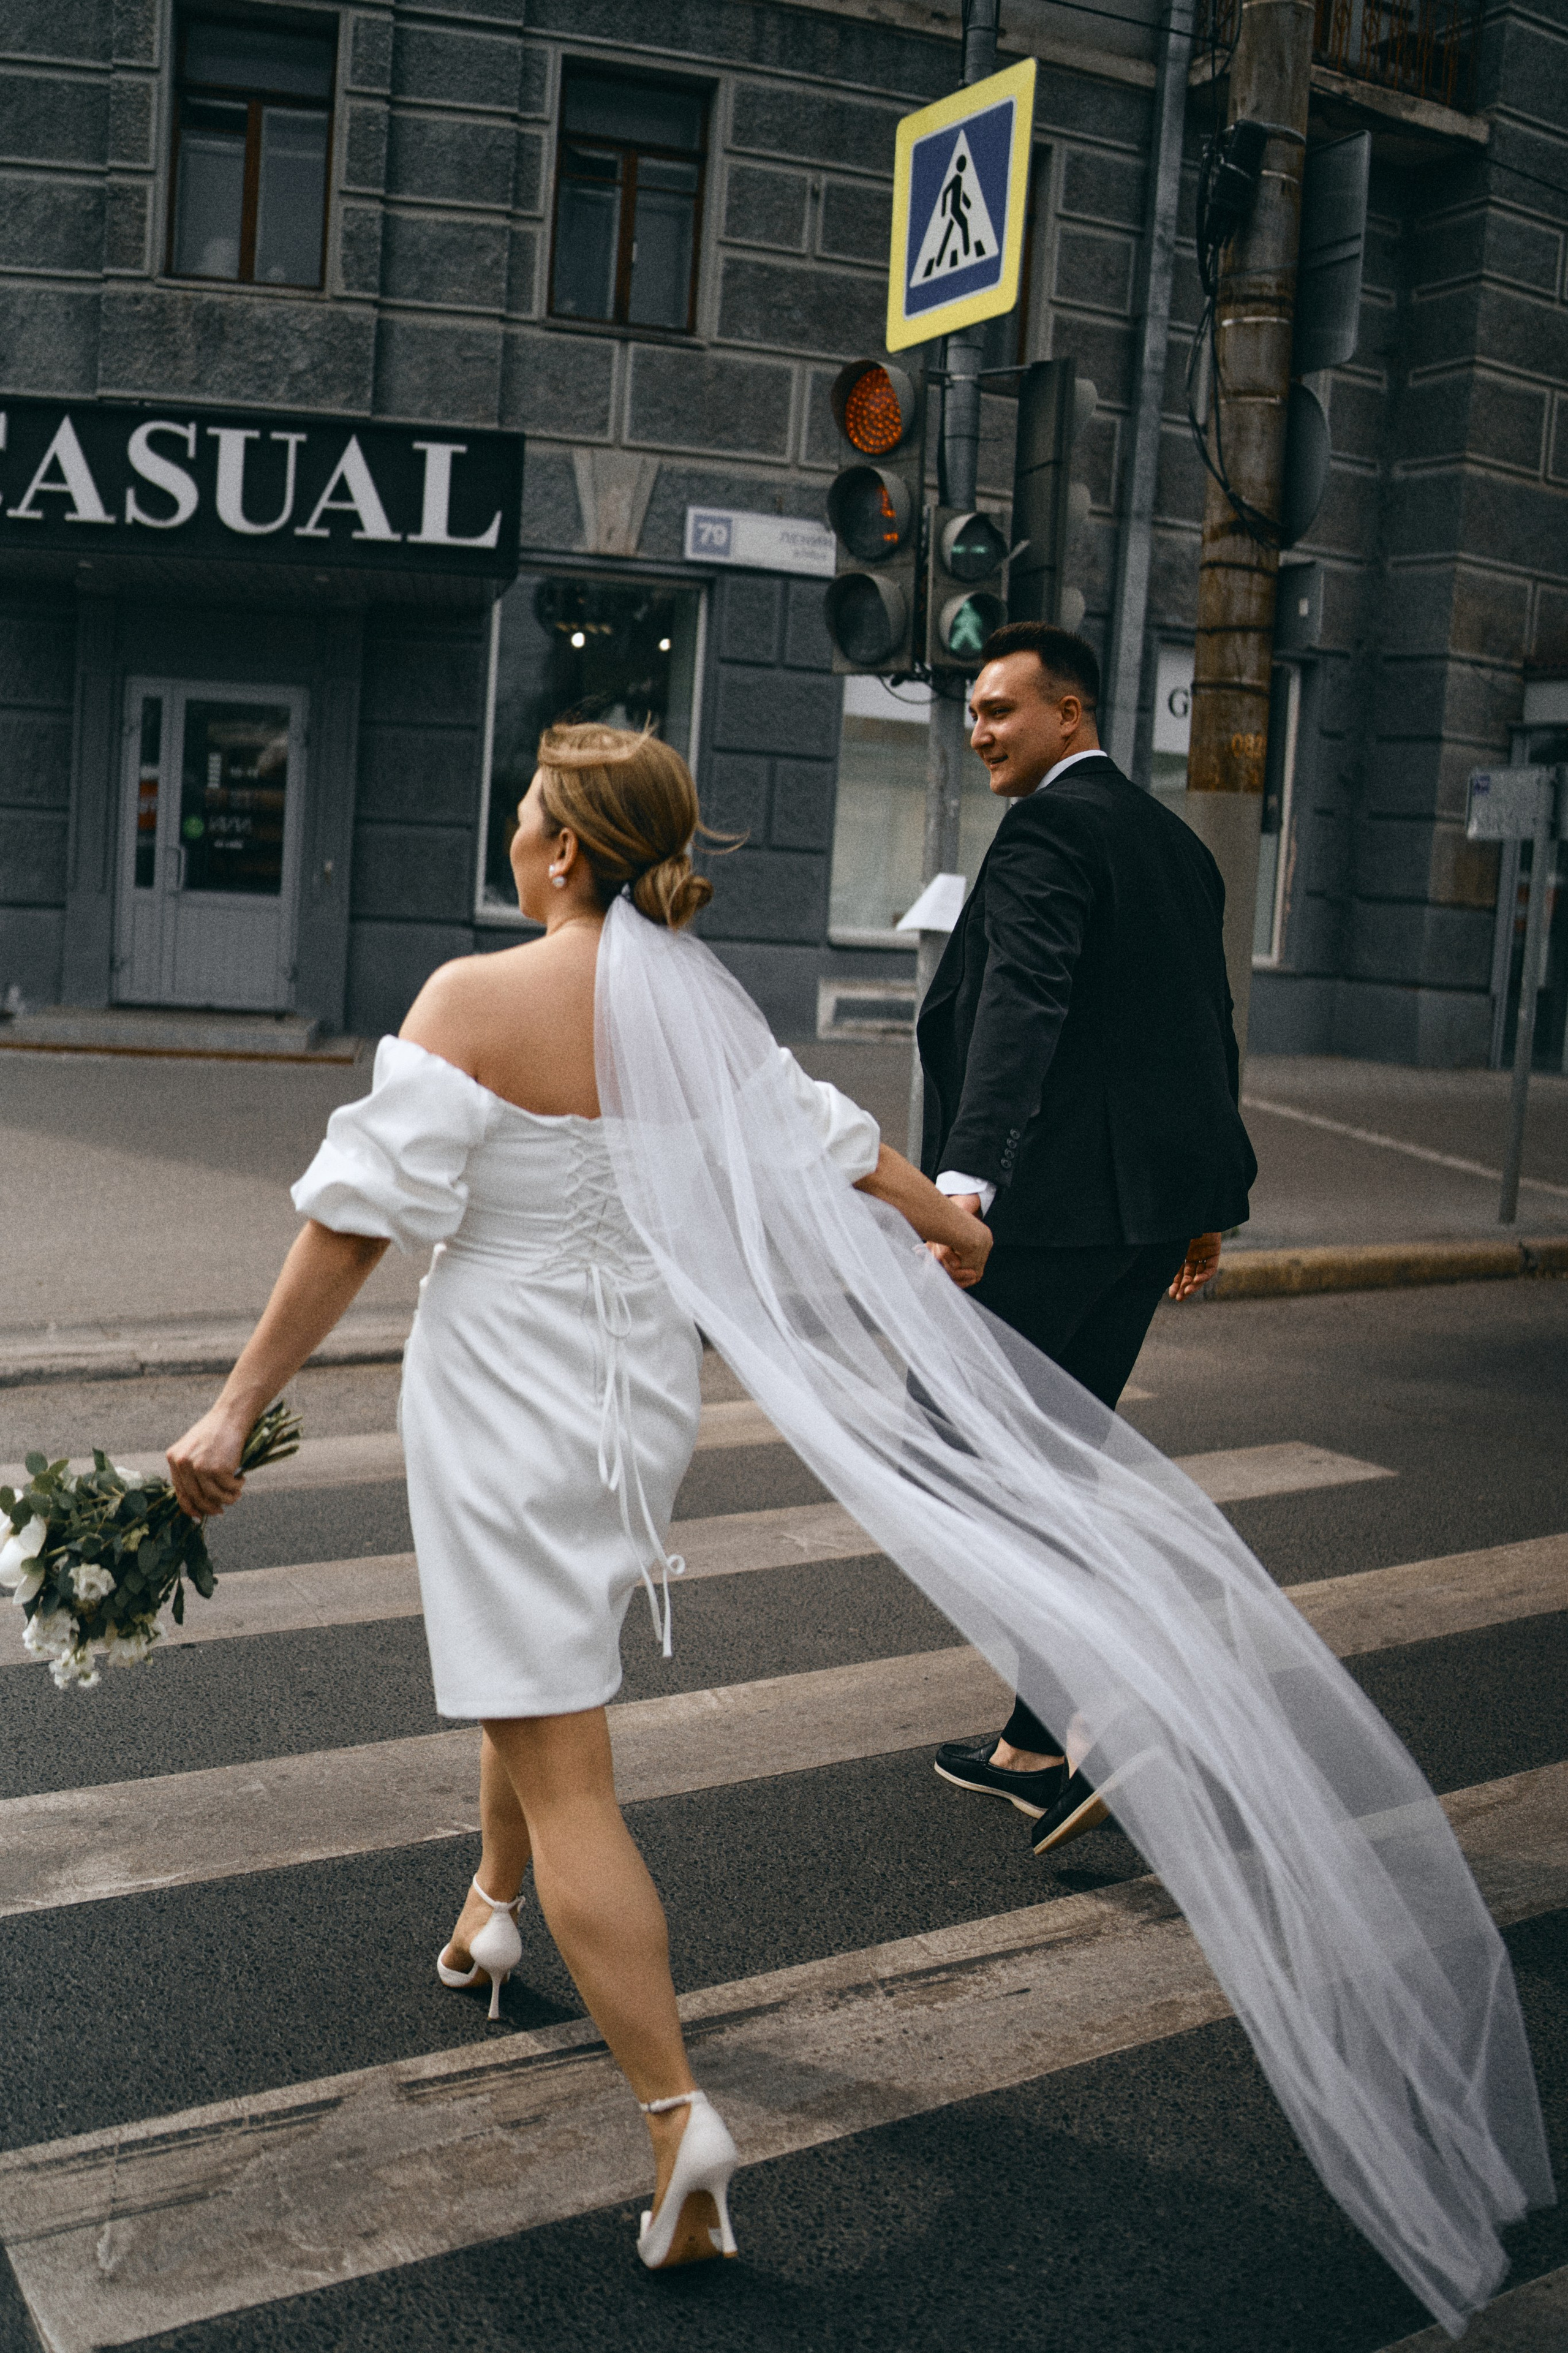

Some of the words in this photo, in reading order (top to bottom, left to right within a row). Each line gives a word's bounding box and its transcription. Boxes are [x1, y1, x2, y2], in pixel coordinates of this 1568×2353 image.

[0, 411, 502, 548] ASUAL
[779, 532, 834, 547] ЛЕНИН
[1167, 686, 1189, 719] G
